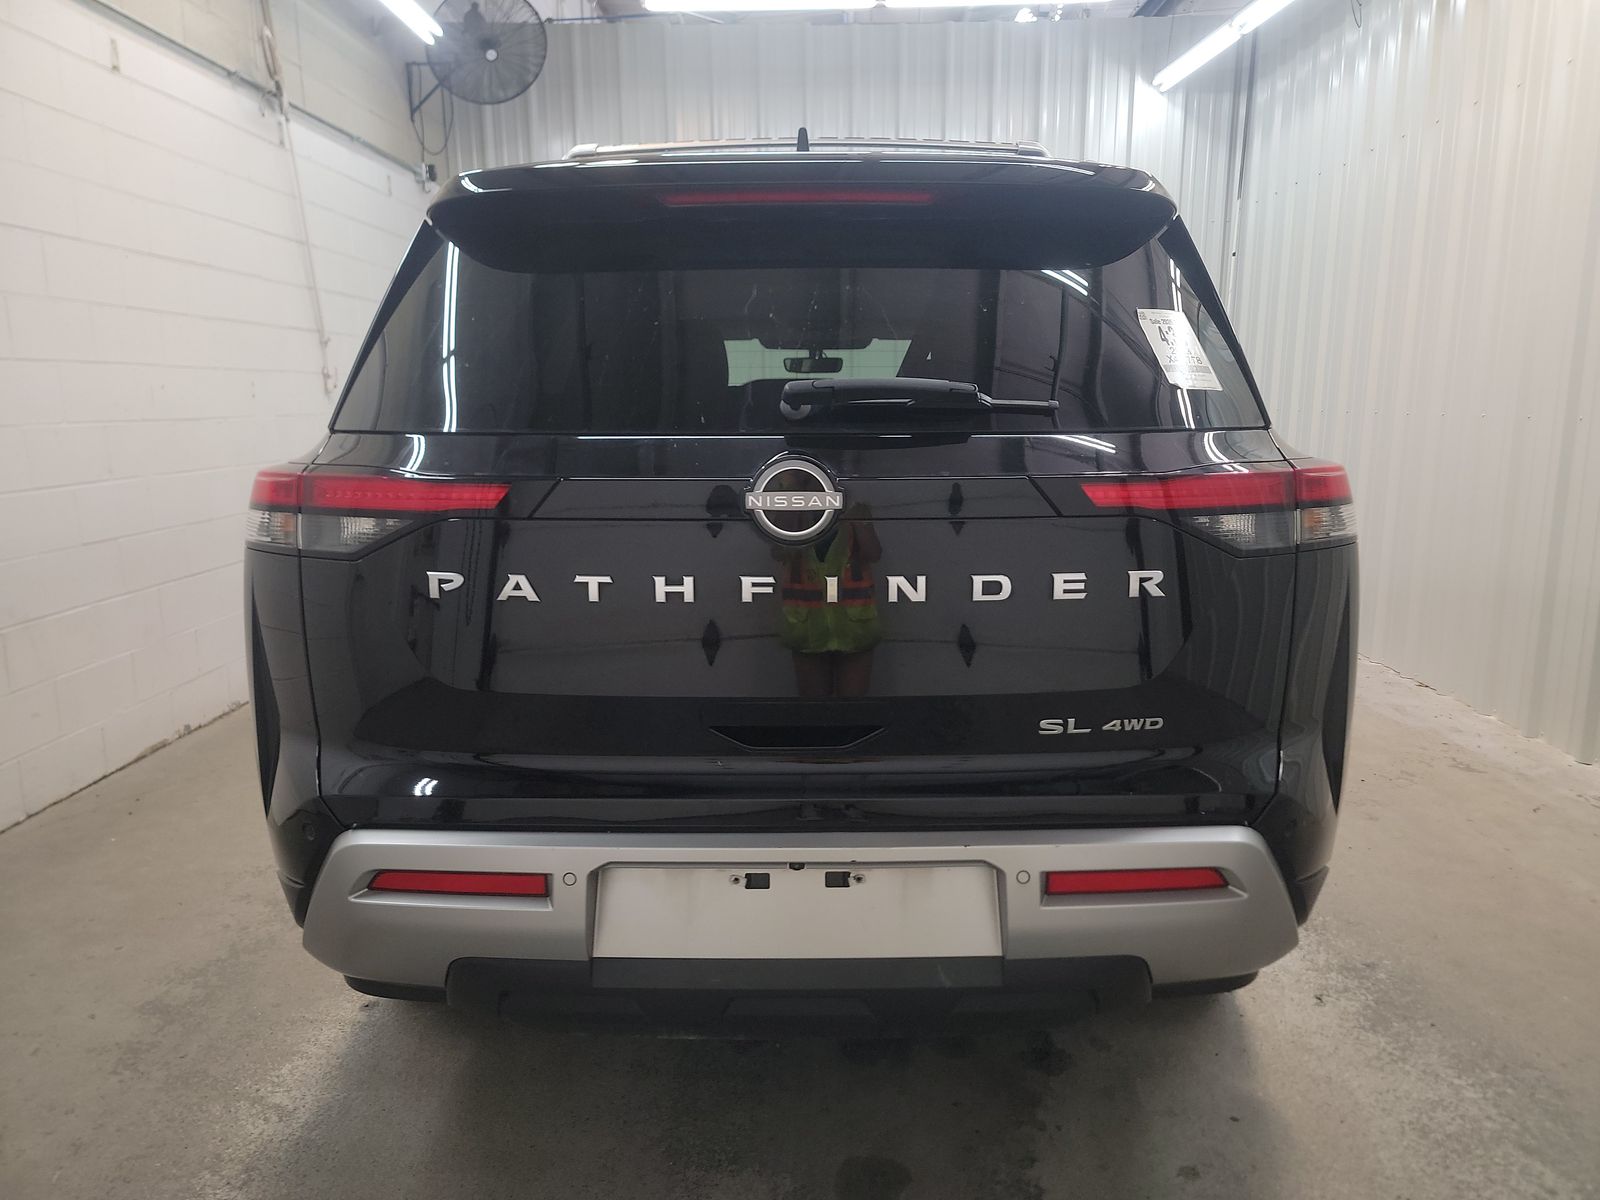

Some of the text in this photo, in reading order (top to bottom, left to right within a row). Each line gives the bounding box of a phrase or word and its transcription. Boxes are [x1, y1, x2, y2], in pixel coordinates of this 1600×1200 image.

[747, 495, 840, 507] NISSAN
[426, 570, 1167, 603] PATHFINDER
[1038, 717, 1164, 735] SL 4WD
